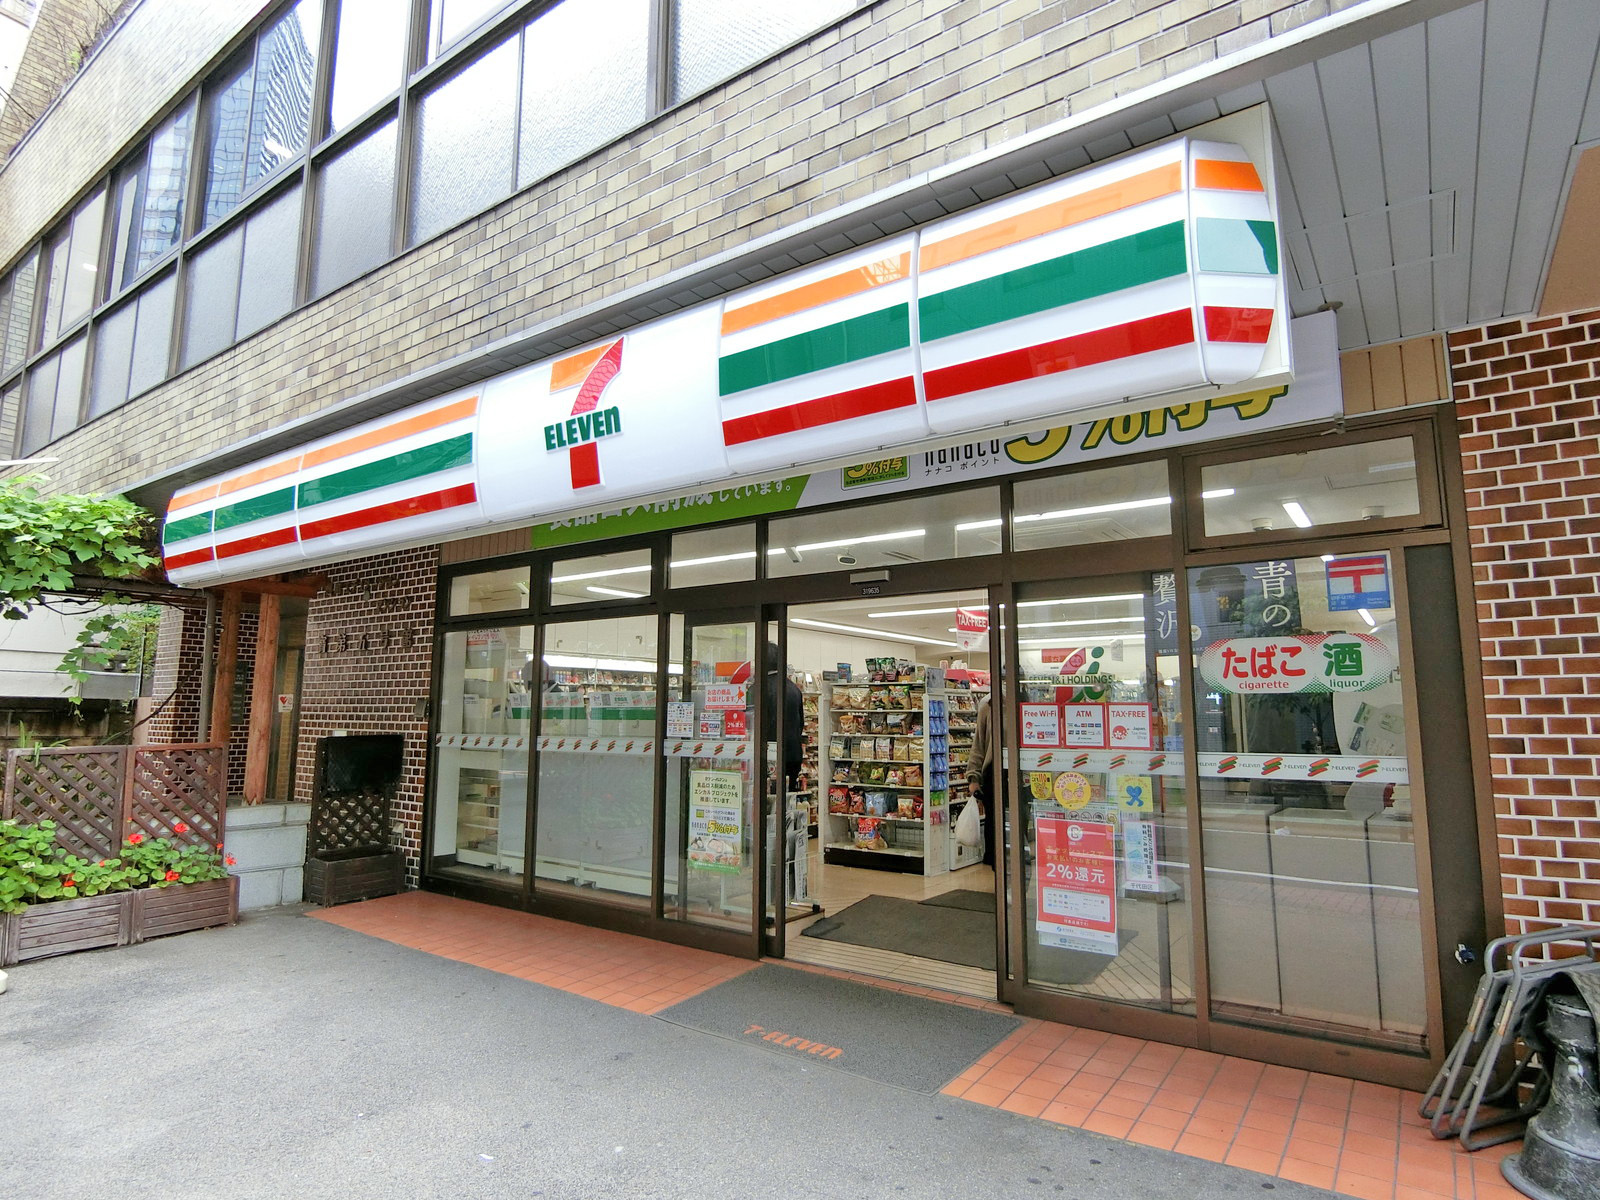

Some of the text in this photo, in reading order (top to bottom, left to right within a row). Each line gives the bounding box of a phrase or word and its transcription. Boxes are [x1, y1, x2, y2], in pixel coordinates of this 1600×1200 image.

[925, 456, 1000, 477] ナナコ ポイント
[1252, 561, 1293, 627] 青の
[1222, 644, 1306, 679] たばこ
[1323, 643, 1363, 676] 酒
[1067, 674, 1113, 684] HOLDINGS
[1239, 679, 1365, 691] cigarette liquor
[1046, 863, 1105, 884] 2%還元
